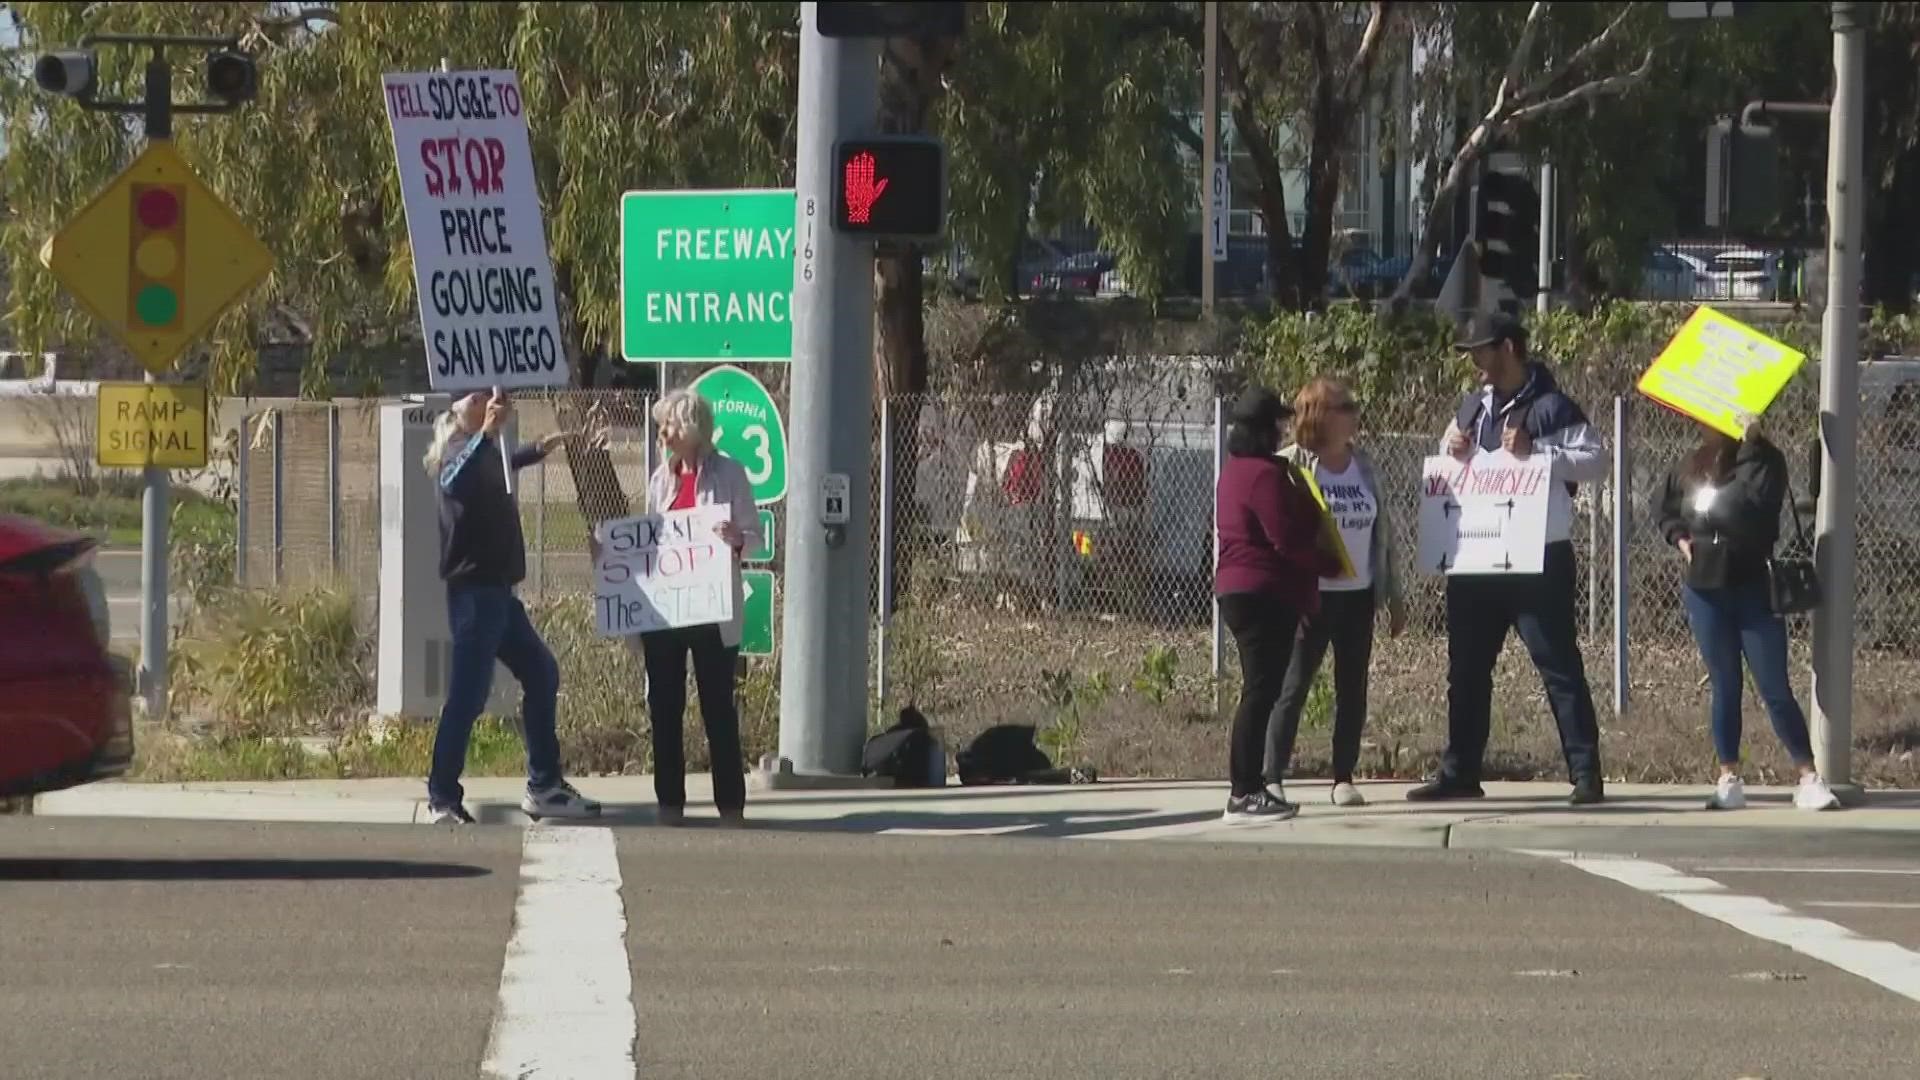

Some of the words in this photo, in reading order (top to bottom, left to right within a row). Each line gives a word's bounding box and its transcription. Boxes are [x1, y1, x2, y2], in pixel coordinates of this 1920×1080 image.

[387, 83, 429, 118] TELL
[428, 76, 497, 120] SDG&E
[493, 82, 521, 118] TO
[420, 137, 506, 198] STOP
[440, 207, 512, 256] PRICE
[656, 227, 792, 260] FREEWAY
[431, 266, 542, 317] GOUGING
[434, 328, 485, 377] SAN
[489, 325, 556, 375] DIEGO
[117, 401, 187, 422] RAMP
[712, 399, 767, 421] IFORNIA
[109, 431, 196, 451] SIGNAL
[602, 544, 714, 584] STOP
[596, 593, 643, 632] The
